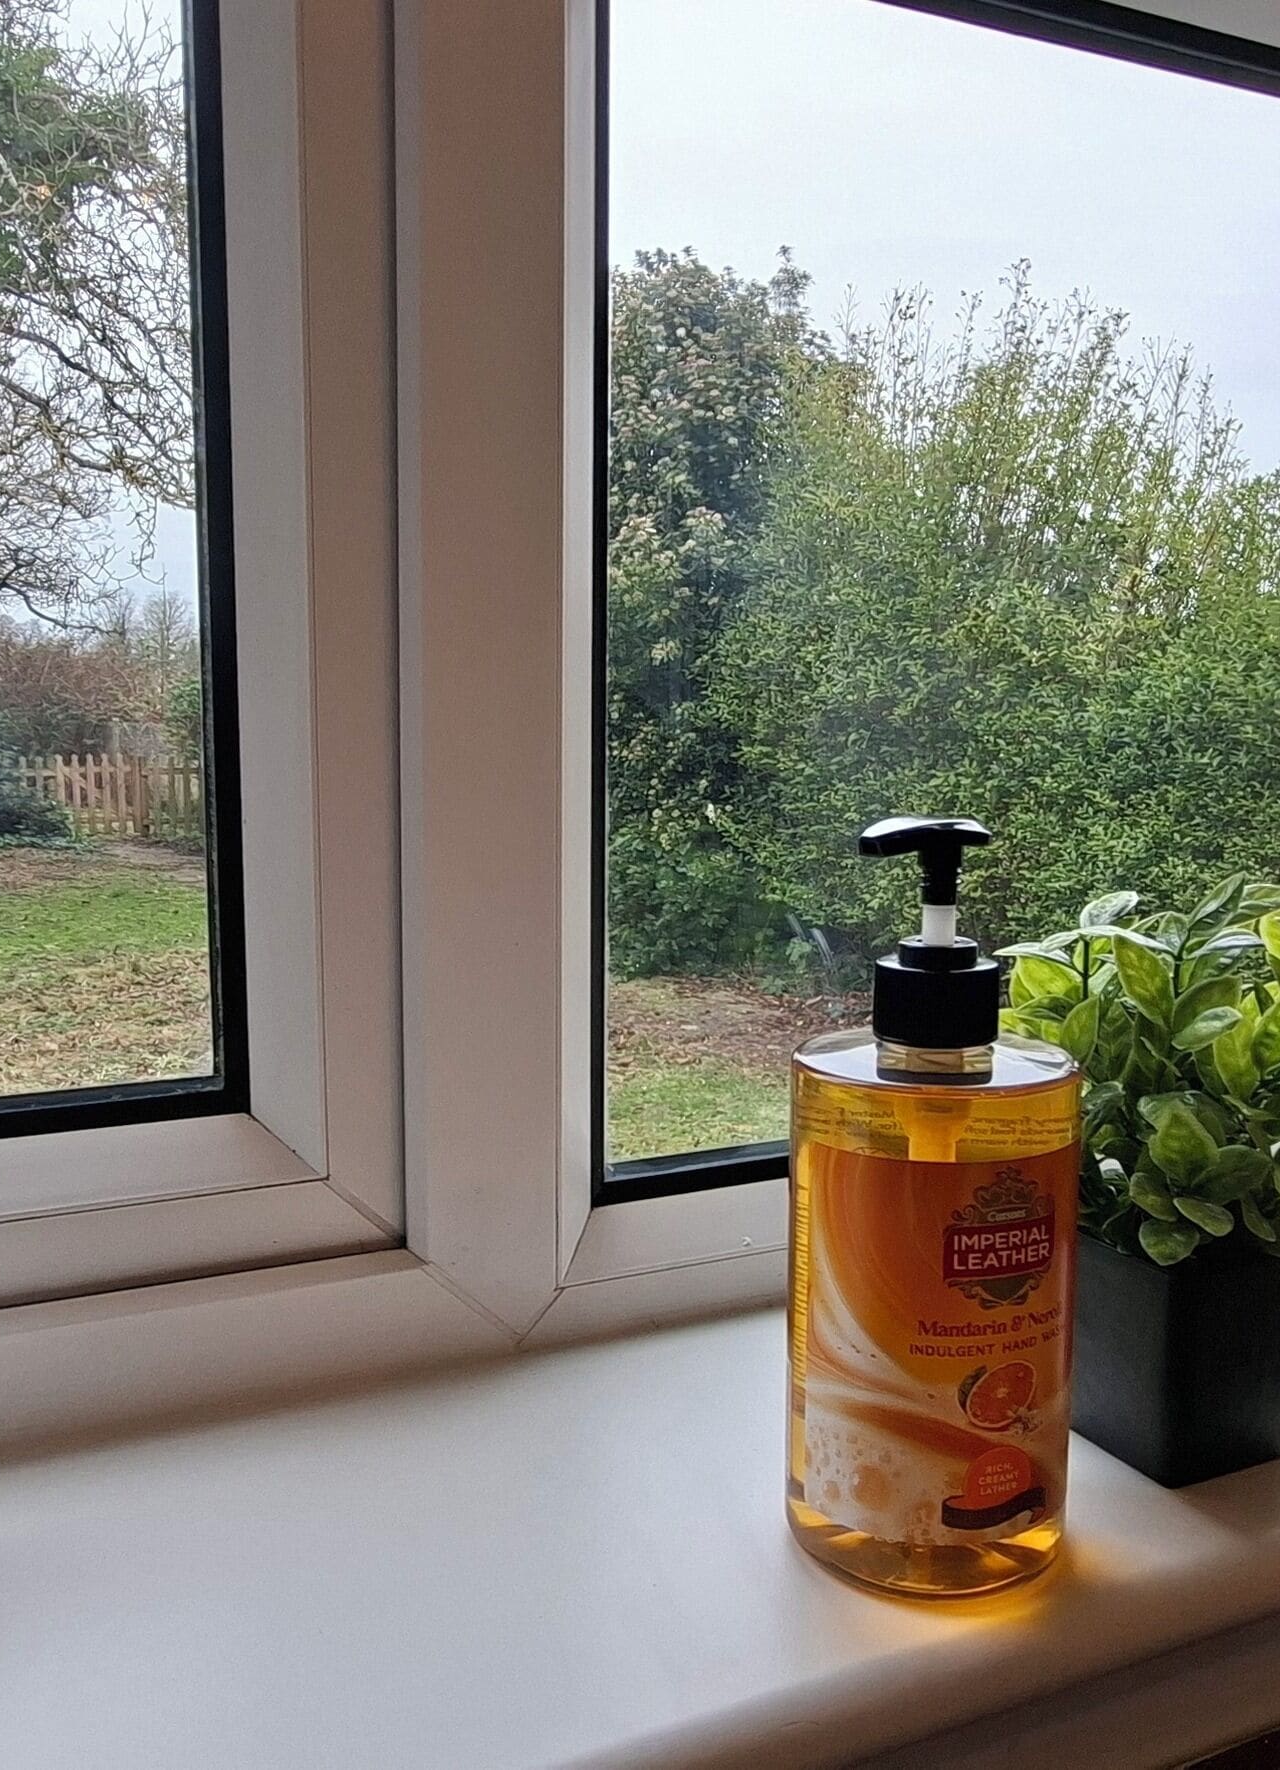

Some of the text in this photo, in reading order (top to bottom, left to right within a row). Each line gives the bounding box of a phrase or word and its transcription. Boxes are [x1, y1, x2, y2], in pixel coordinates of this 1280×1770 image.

[953, 1224, 1049, 1251] IMPERIAL
[953, 1242, 1050, 1270] LEATHER
[917, 1319, 1008, 1338] Mandarin
[1011, 1314, 1026, 1332] &
[909, 1343, 996, 1358] INDULGENT
[1002, 1336, 1038, 1352] HAND
[978, 1471, 1019, 1485] CREAMY
[980, 1481, 1018, 1495] LATHER
